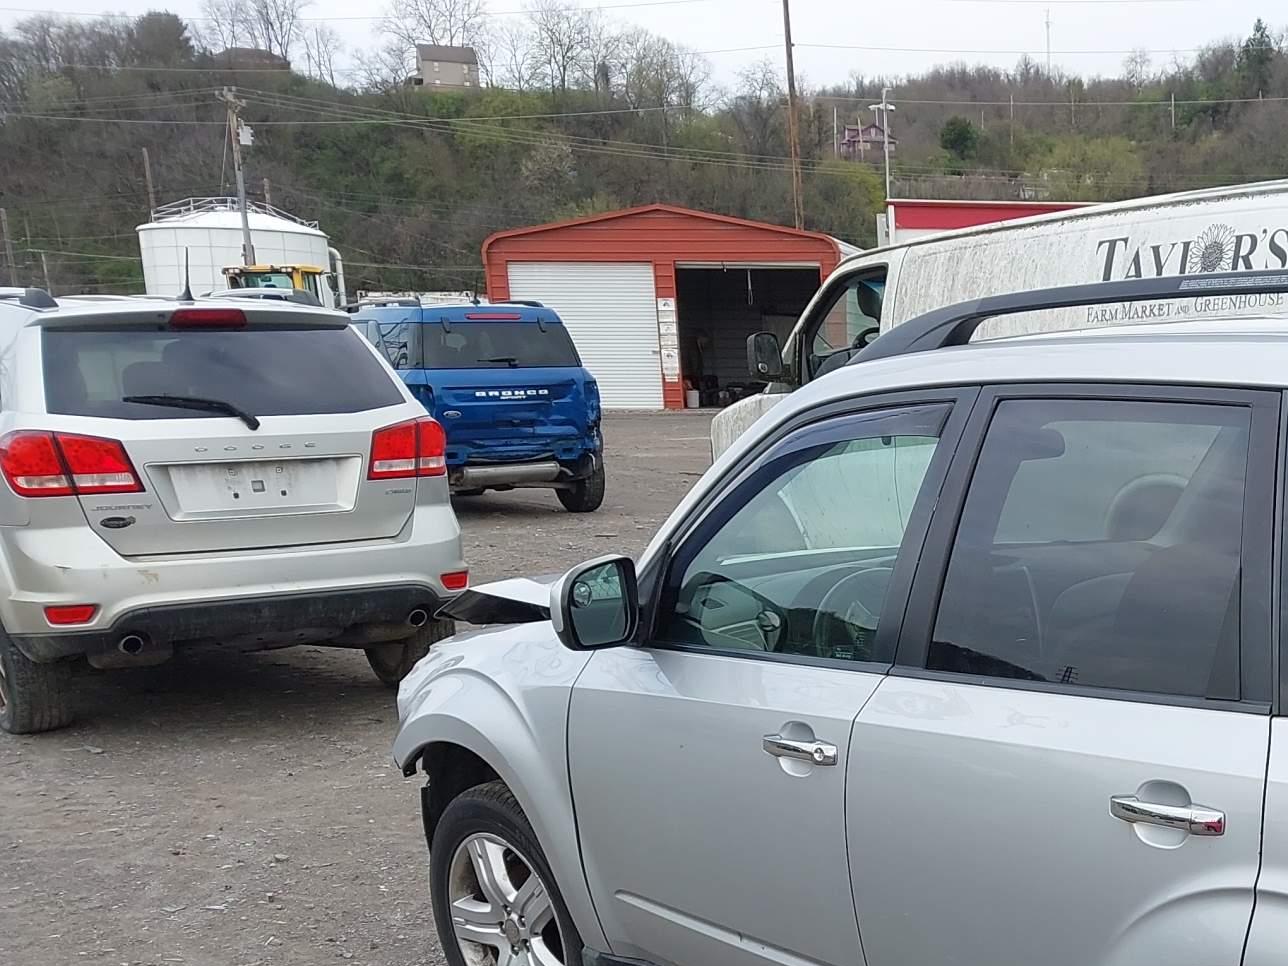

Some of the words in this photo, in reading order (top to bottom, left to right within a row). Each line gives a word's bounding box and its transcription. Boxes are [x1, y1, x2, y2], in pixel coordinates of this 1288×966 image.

[1087, 306, 1118, 323] FARM
[1121, 302, 1173, 321] MARKET
[1194, 292, 1284, 313] GREENHOUSE
[475, 389, 549, 397] BRONCO
[194, 441, 317, 453] DODGE
[90, 503, 153, 512] JOURNEY
